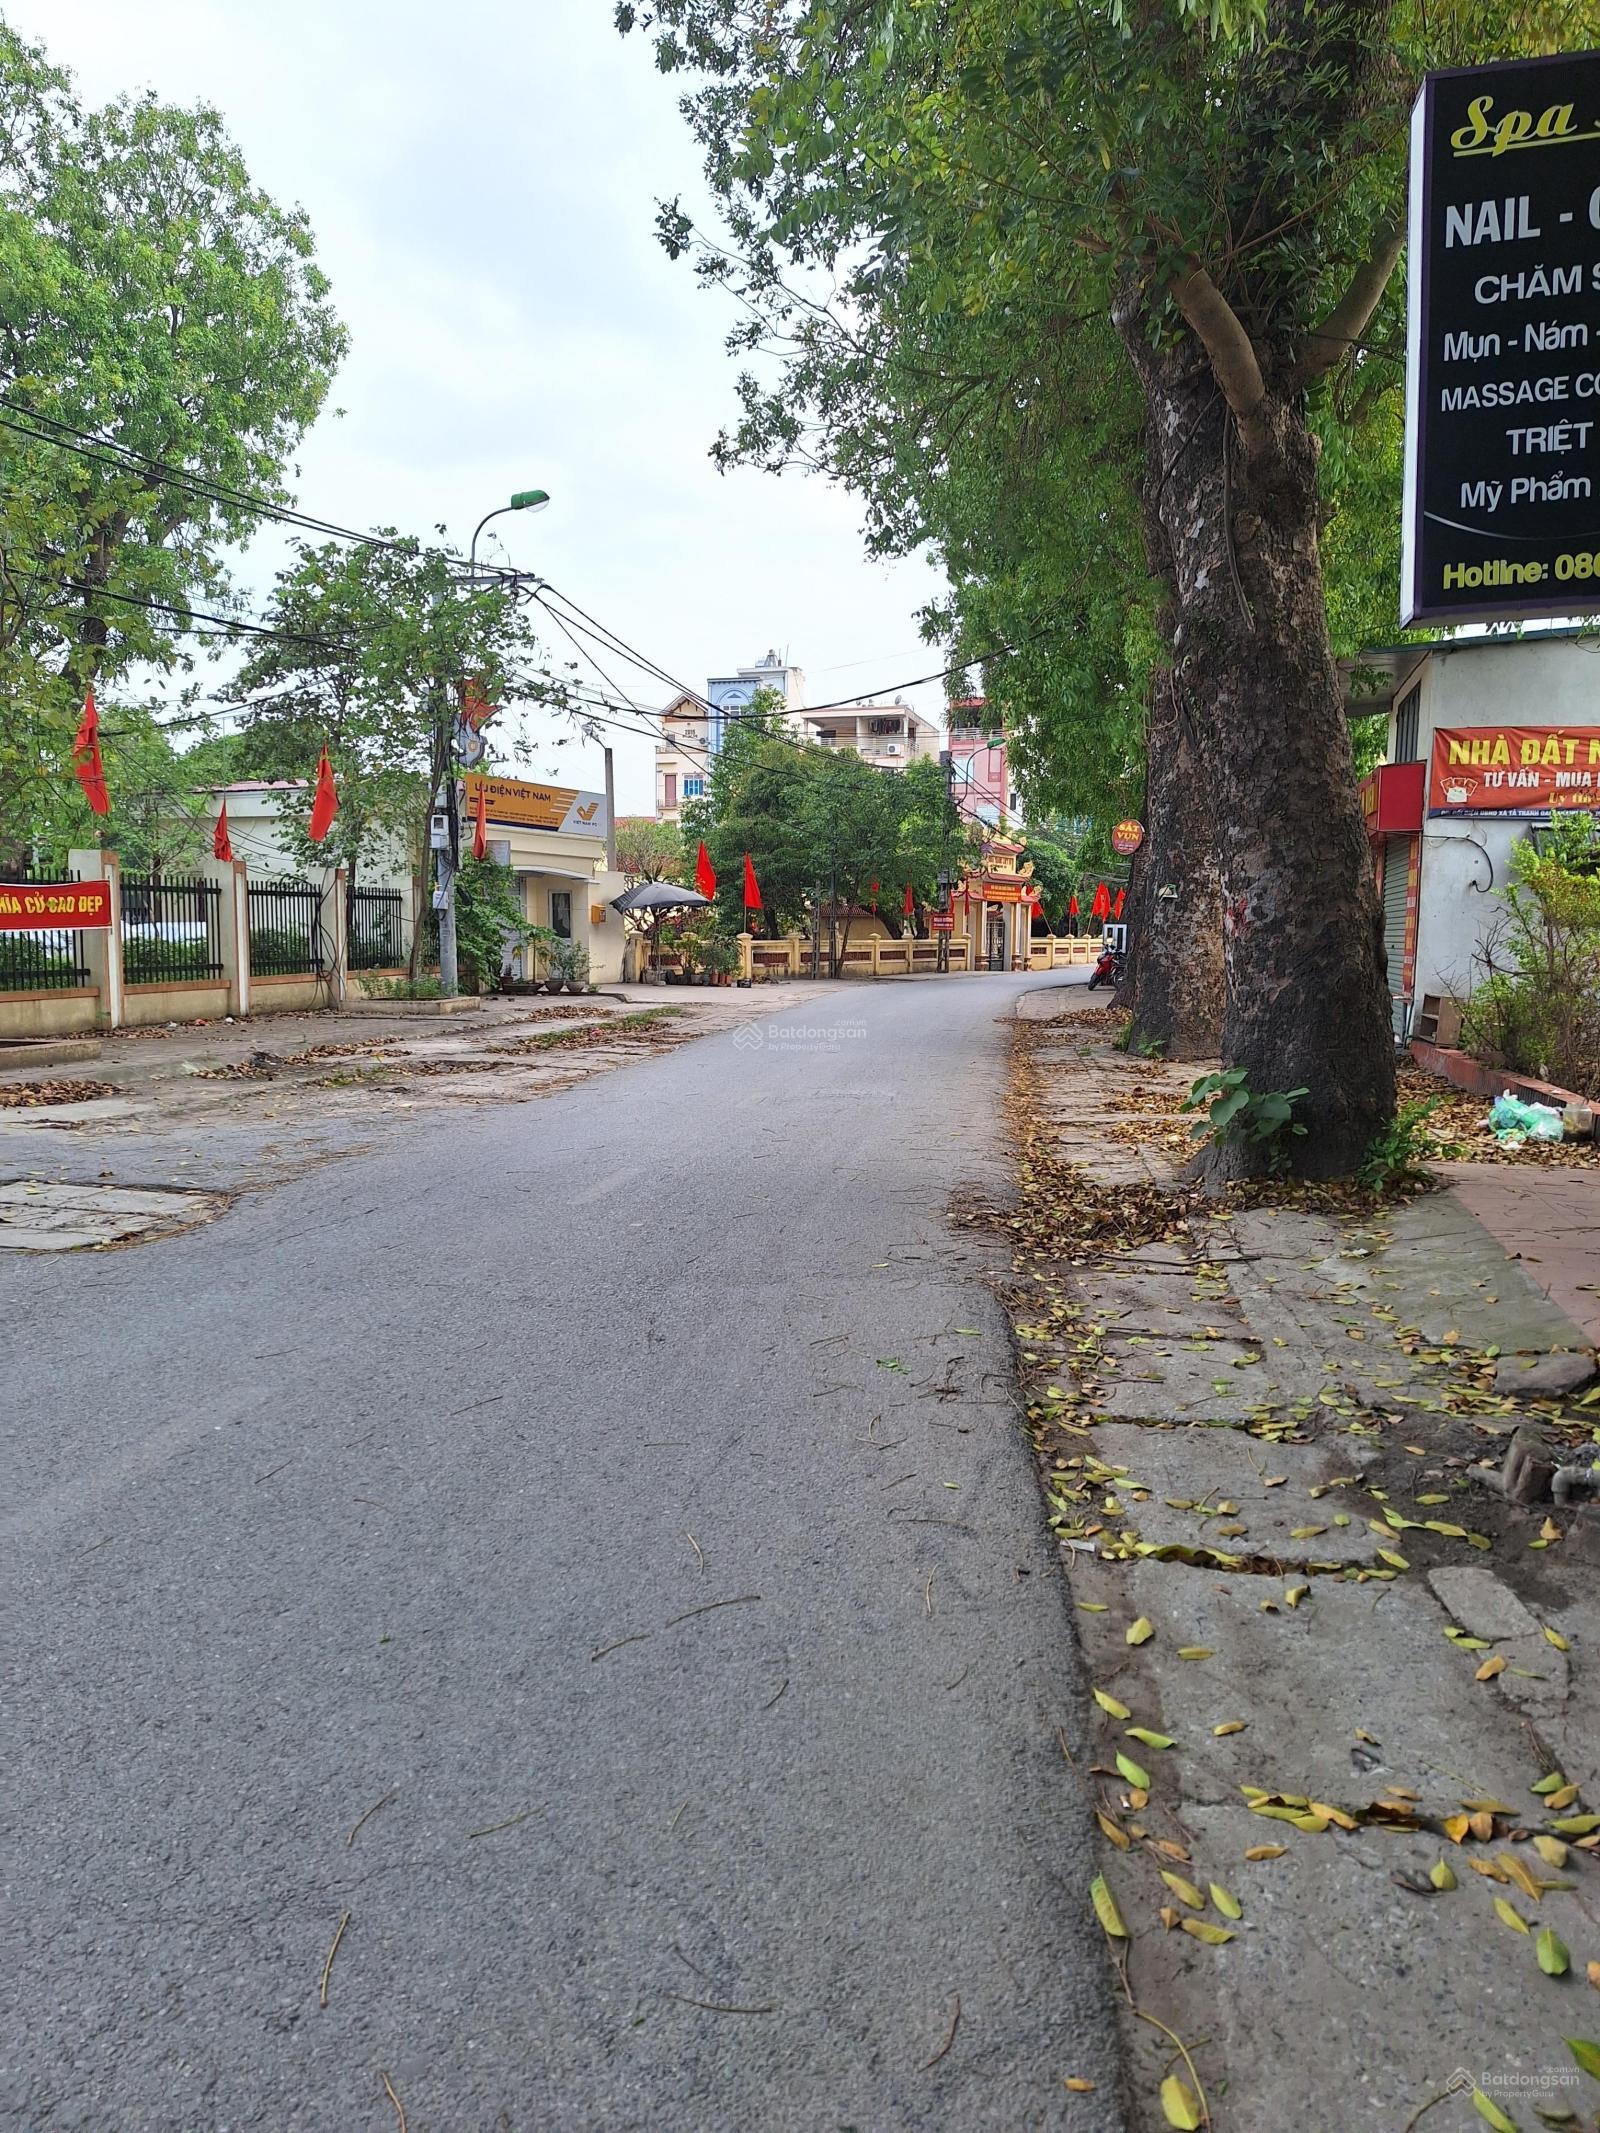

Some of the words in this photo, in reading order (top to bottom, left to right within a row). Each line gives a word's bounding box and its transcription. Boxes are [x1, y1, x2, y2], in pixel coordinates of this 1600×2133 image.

[1450, 95, 1578, 157] Spa
[1445, 195, 1541, 248] NAIL
[1474, 263, 1582, 304] CHĂM
[1443, 330, 1500, 363] Mụn
[1525, 319, 1588, 353] Nám
[1441, 375, 1569, 412] MASSAGE
[1505, 418, 1594, 455] TRIỆT
[1460, 480, 1503, 513] Mỹ
[1510, 470, 1591, 504] Phẩm
[1442, 559, 1549, 590] Hotline:
[1448, 733, 1510, 765] NHÀ
[1520, 729, 1579, 765] ĐẤT
[490, 784, 512, 798] ĐIỆN
[512, 788, 531, 800] VIỆT
[532, 791, 551, 803] NAM
[1483, 770, 1505, 787] TƯ
[1508, 767, 1540, 787] VẤN
[1555, 771, 1592, 788] MUA
[48, 895, 76, 914] CAO
